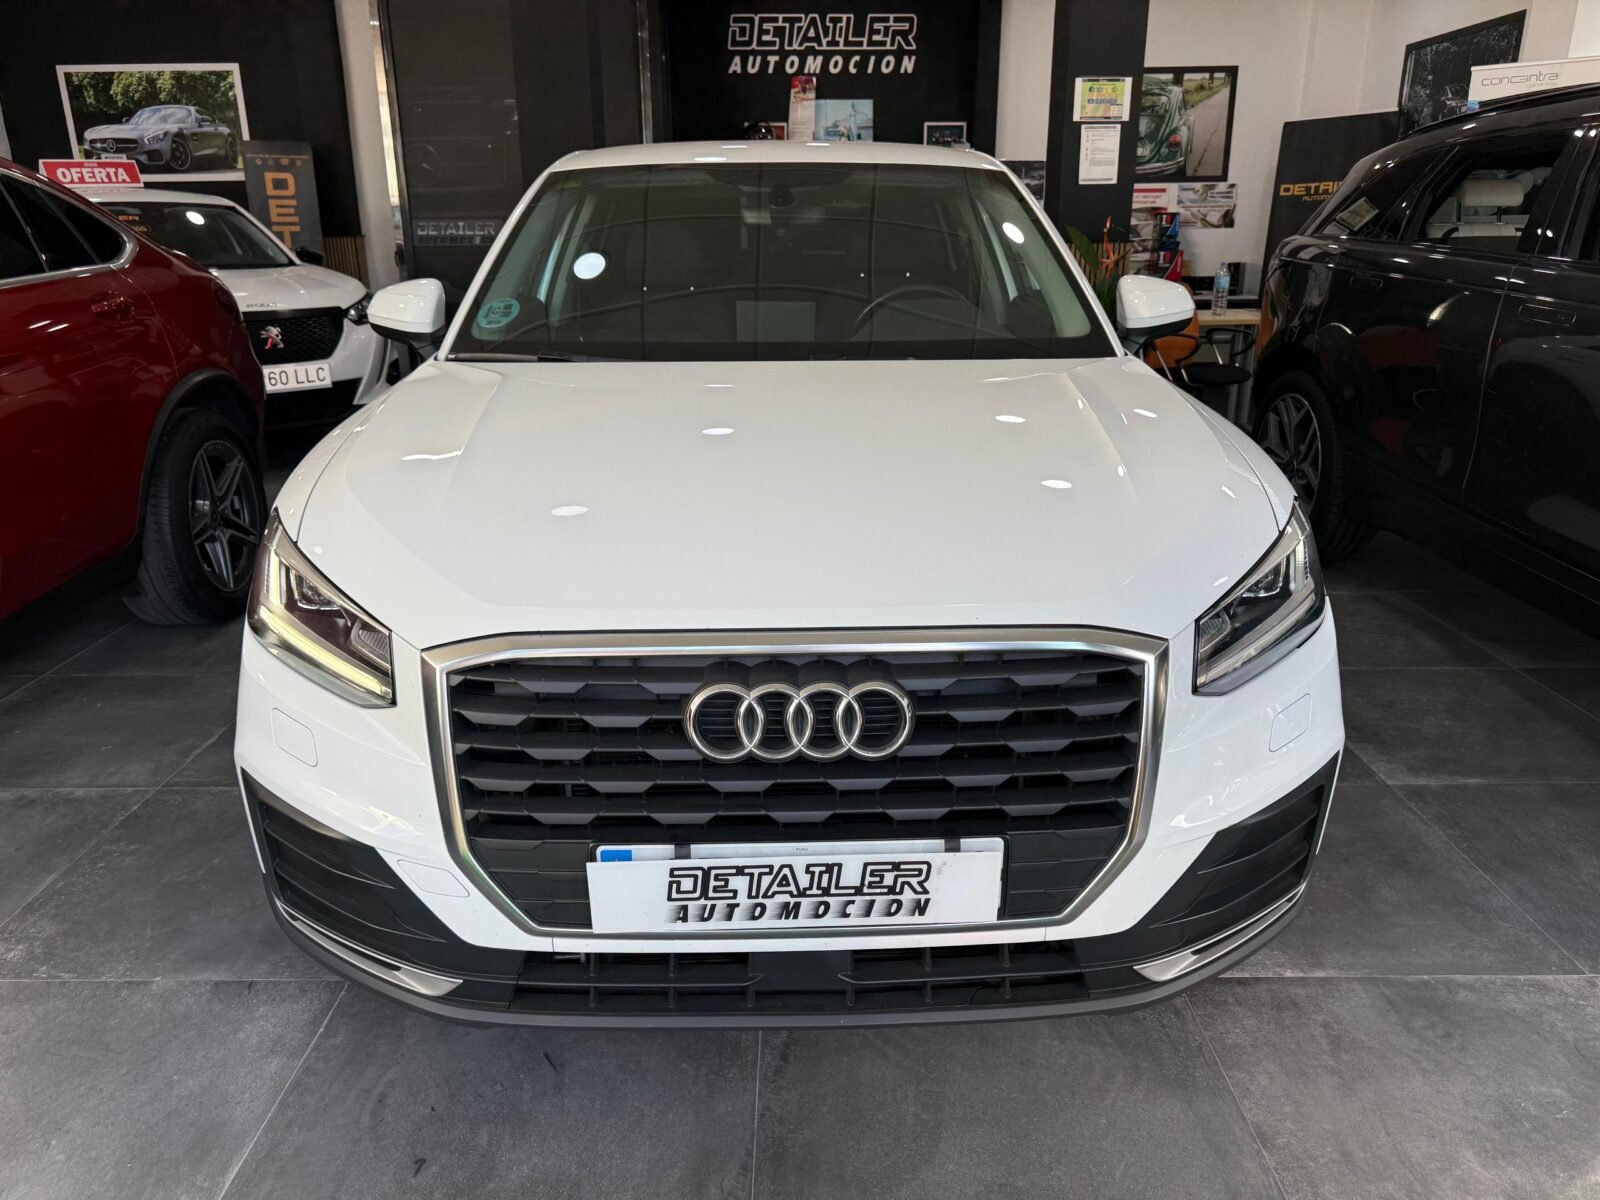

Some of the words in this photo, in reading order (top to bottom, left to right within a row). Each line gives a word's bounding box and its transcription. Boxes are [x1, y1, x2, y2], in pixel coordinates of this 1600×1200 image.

[728, 13, 918, 51] DETAILER
[728, 55, 917, 75] AUTOMOCION
[56, 167, 131, 183] OFERTA
[417, 222, 495, 235] DETAILER
[267, 370, 289, 387] 60
[294, 367, 326, 384] LLC
[667, 860, 932, 902] DETAILER
[672, 898, 932, 923] AUTOMOCION
